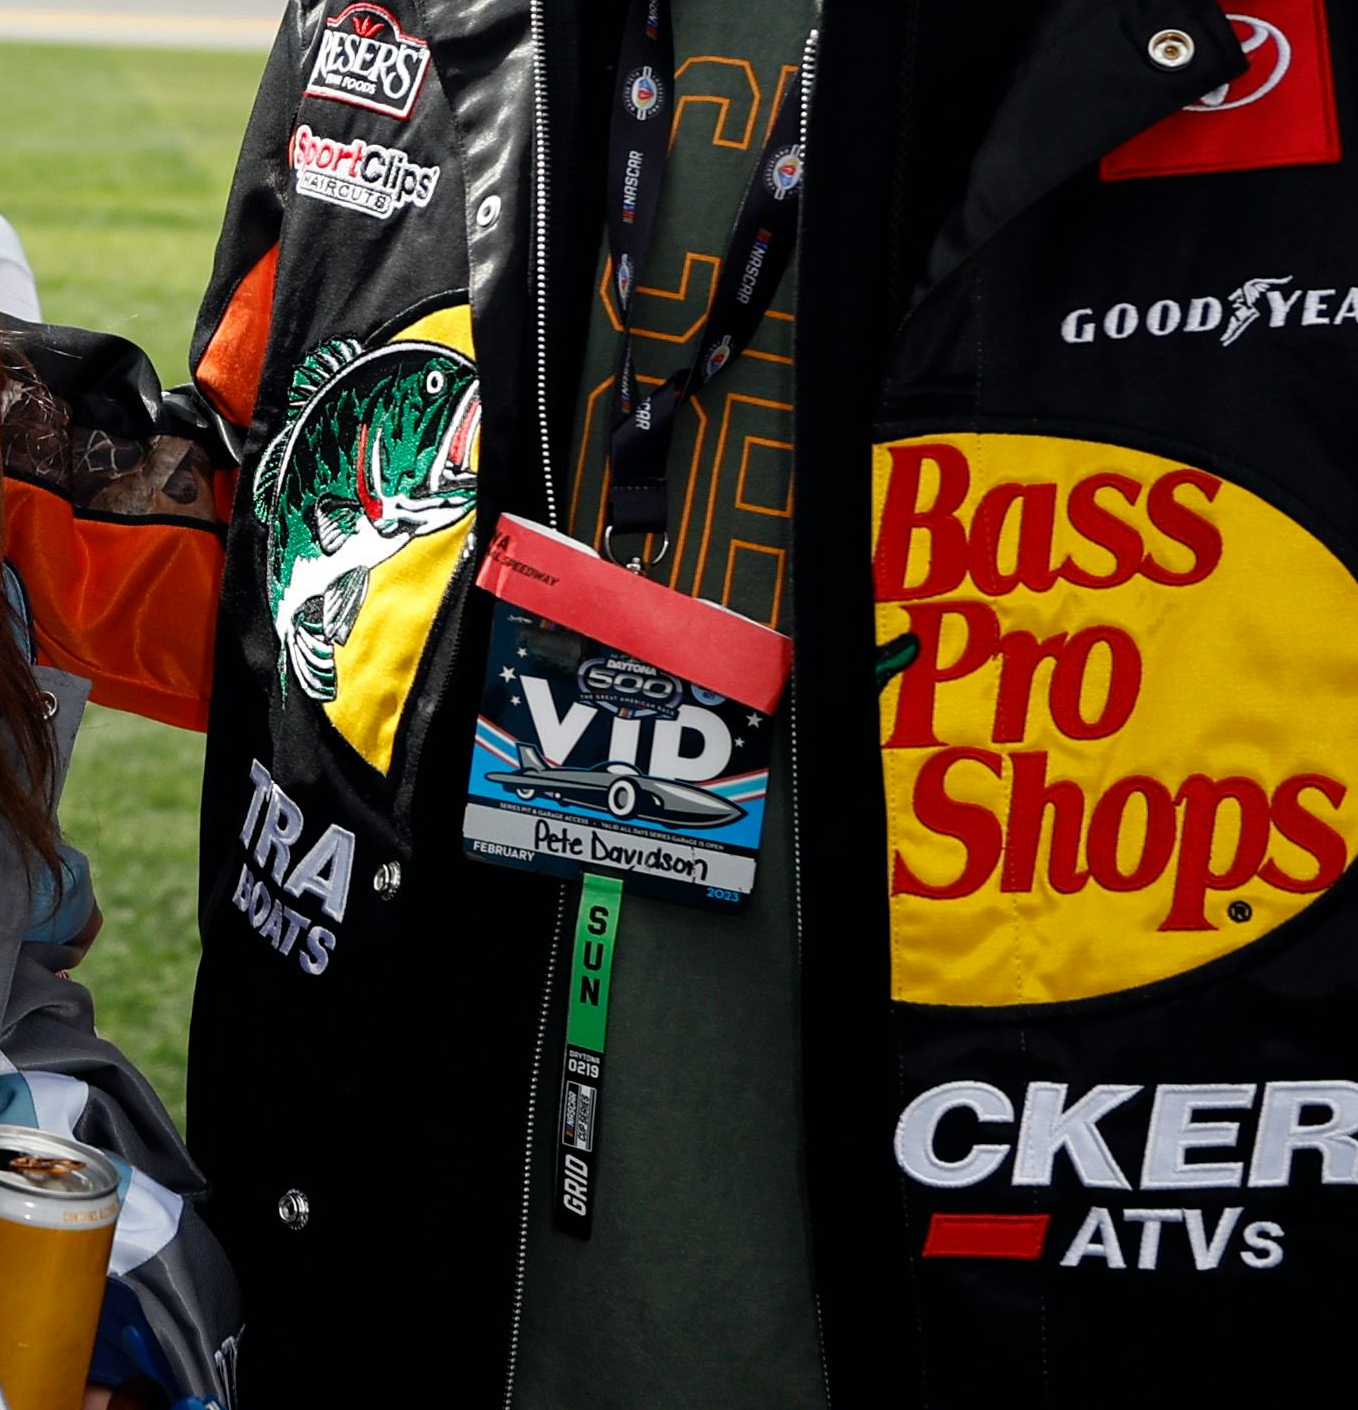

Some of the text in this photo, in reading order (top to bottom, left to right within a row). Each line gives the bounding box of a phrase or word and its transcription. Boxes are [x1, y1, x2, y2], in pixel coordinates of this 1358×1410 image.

[342, 75, 377, 96] FOODS
[623, 150, 644, 208] NASCAR
[736, 246, 768, 305] NASCAR
[871, 443, 1224, 603] Bass
[586, 666, 674, 700] 500
[606, 658, 657, 677] DAYTONA
[880, 598, 1142, 749] Pro
[519, 674, 733, 783] VIP
[472, 840, 535, 863] FEBRUARY
[534, 818, 709, 882] Pete Davidson
[890, 745, 1348, 932] Shops
[232, 863, 337, 977] BOATS
[706, 885, 740, 902] 2023
[579, 905, 609, 1007] SUN
[567, 1057, 600, 1079] 0219
[568, 1049, 601, 1065] DAYTONA
[563, 1153, 589, 1217] GRID
[1059, 1206, 1285, 1271] ATVs
